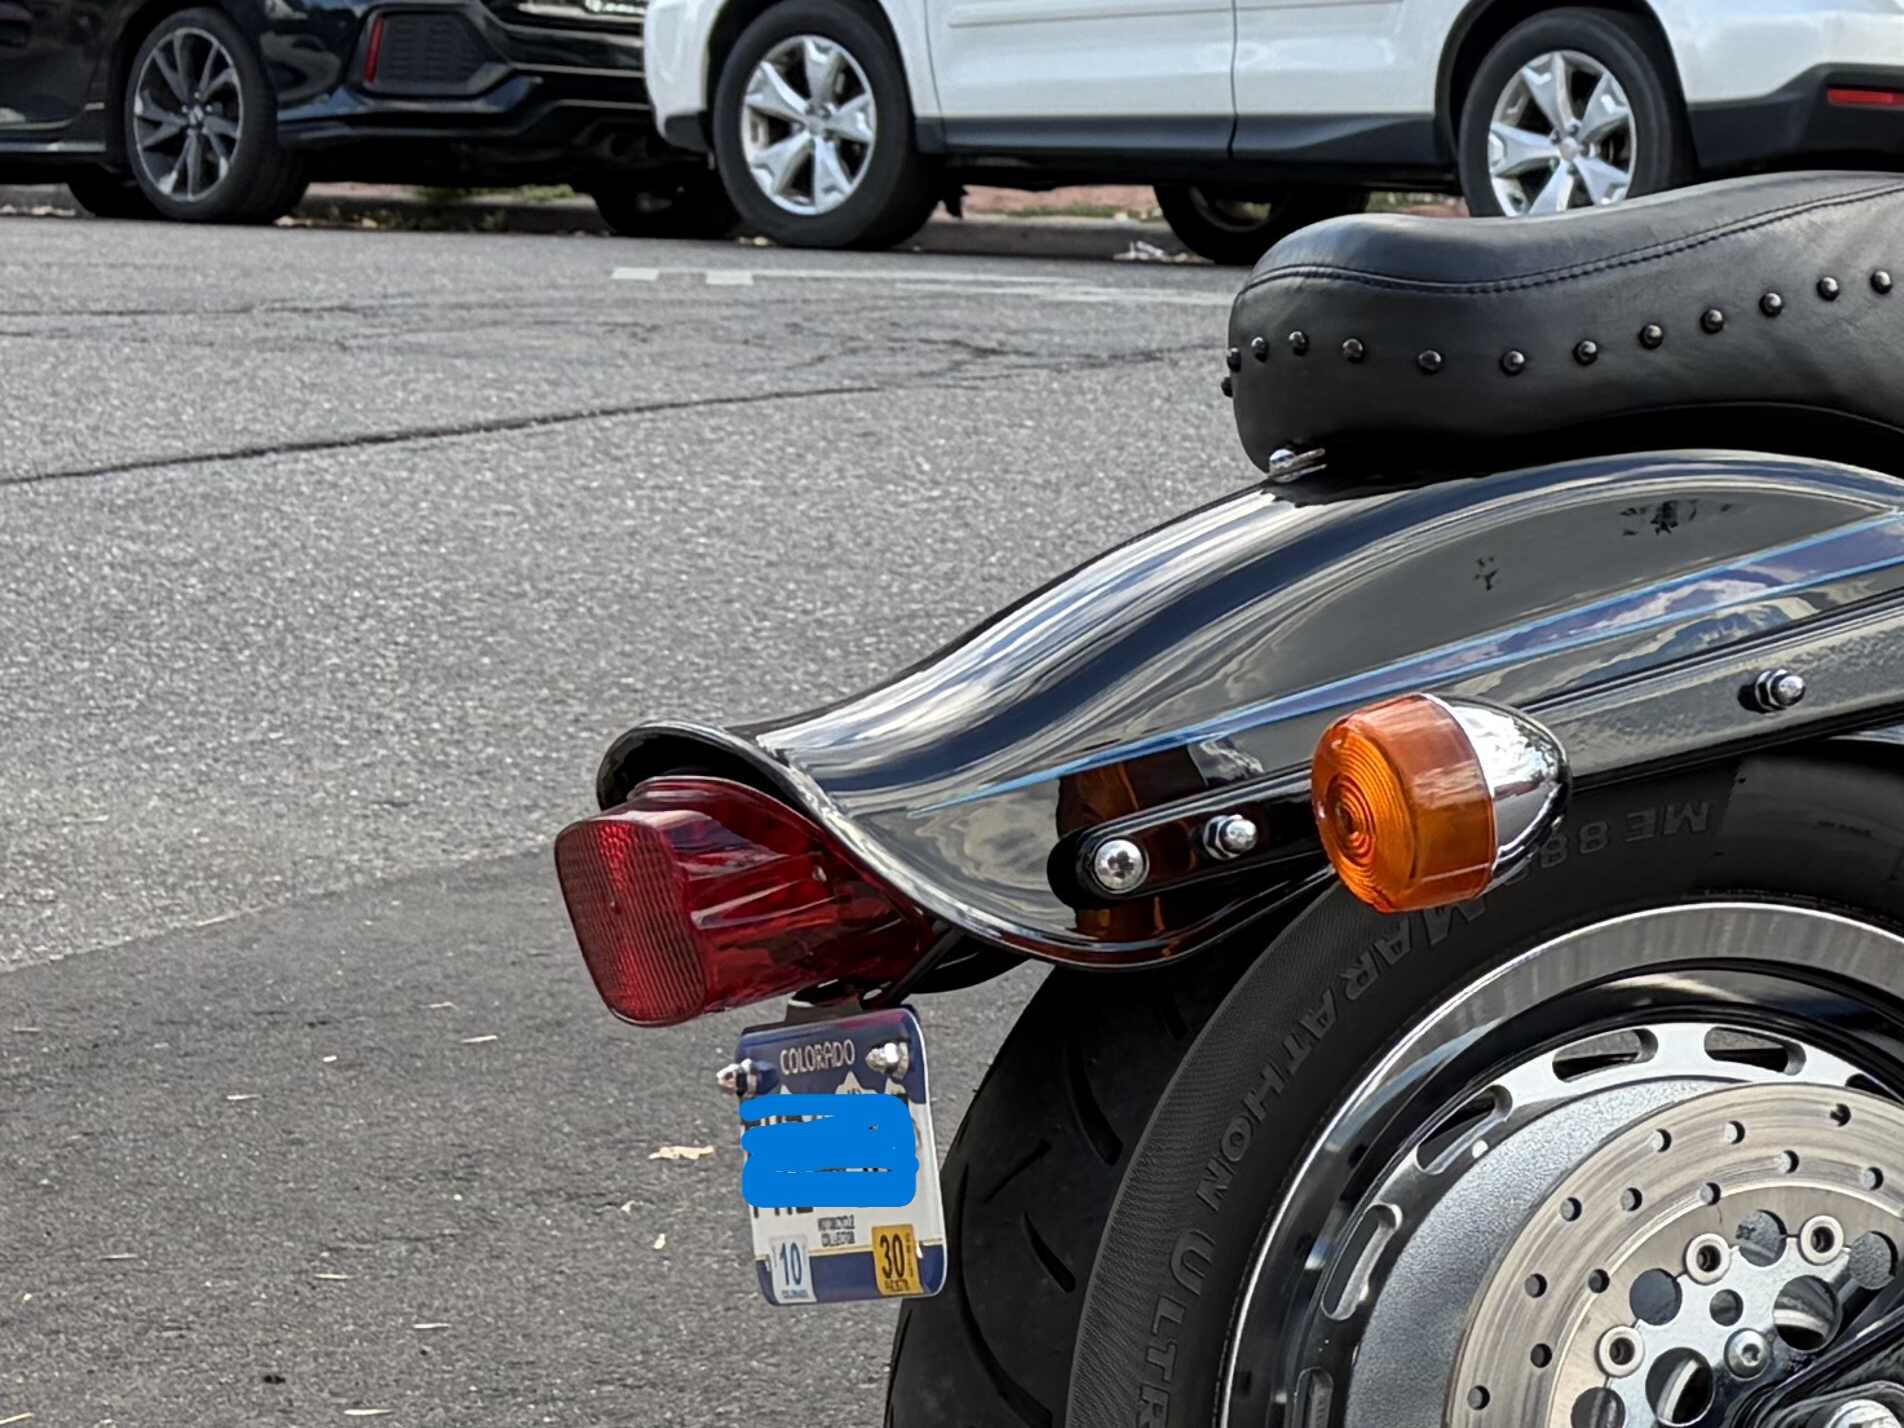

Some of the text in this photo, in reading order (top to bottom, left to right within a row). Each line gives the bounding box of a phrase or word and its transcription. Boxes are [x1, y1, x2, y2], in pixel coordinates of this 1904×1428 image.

[1624, 801, 1710, 844] ME
[780, 1039, 856, 1076] COLORADO
[1195, 901, 1494, 1213] MARATHON
[779, 1243, 802, 1286] 10
[880, 1234, 905, 1279] 30
